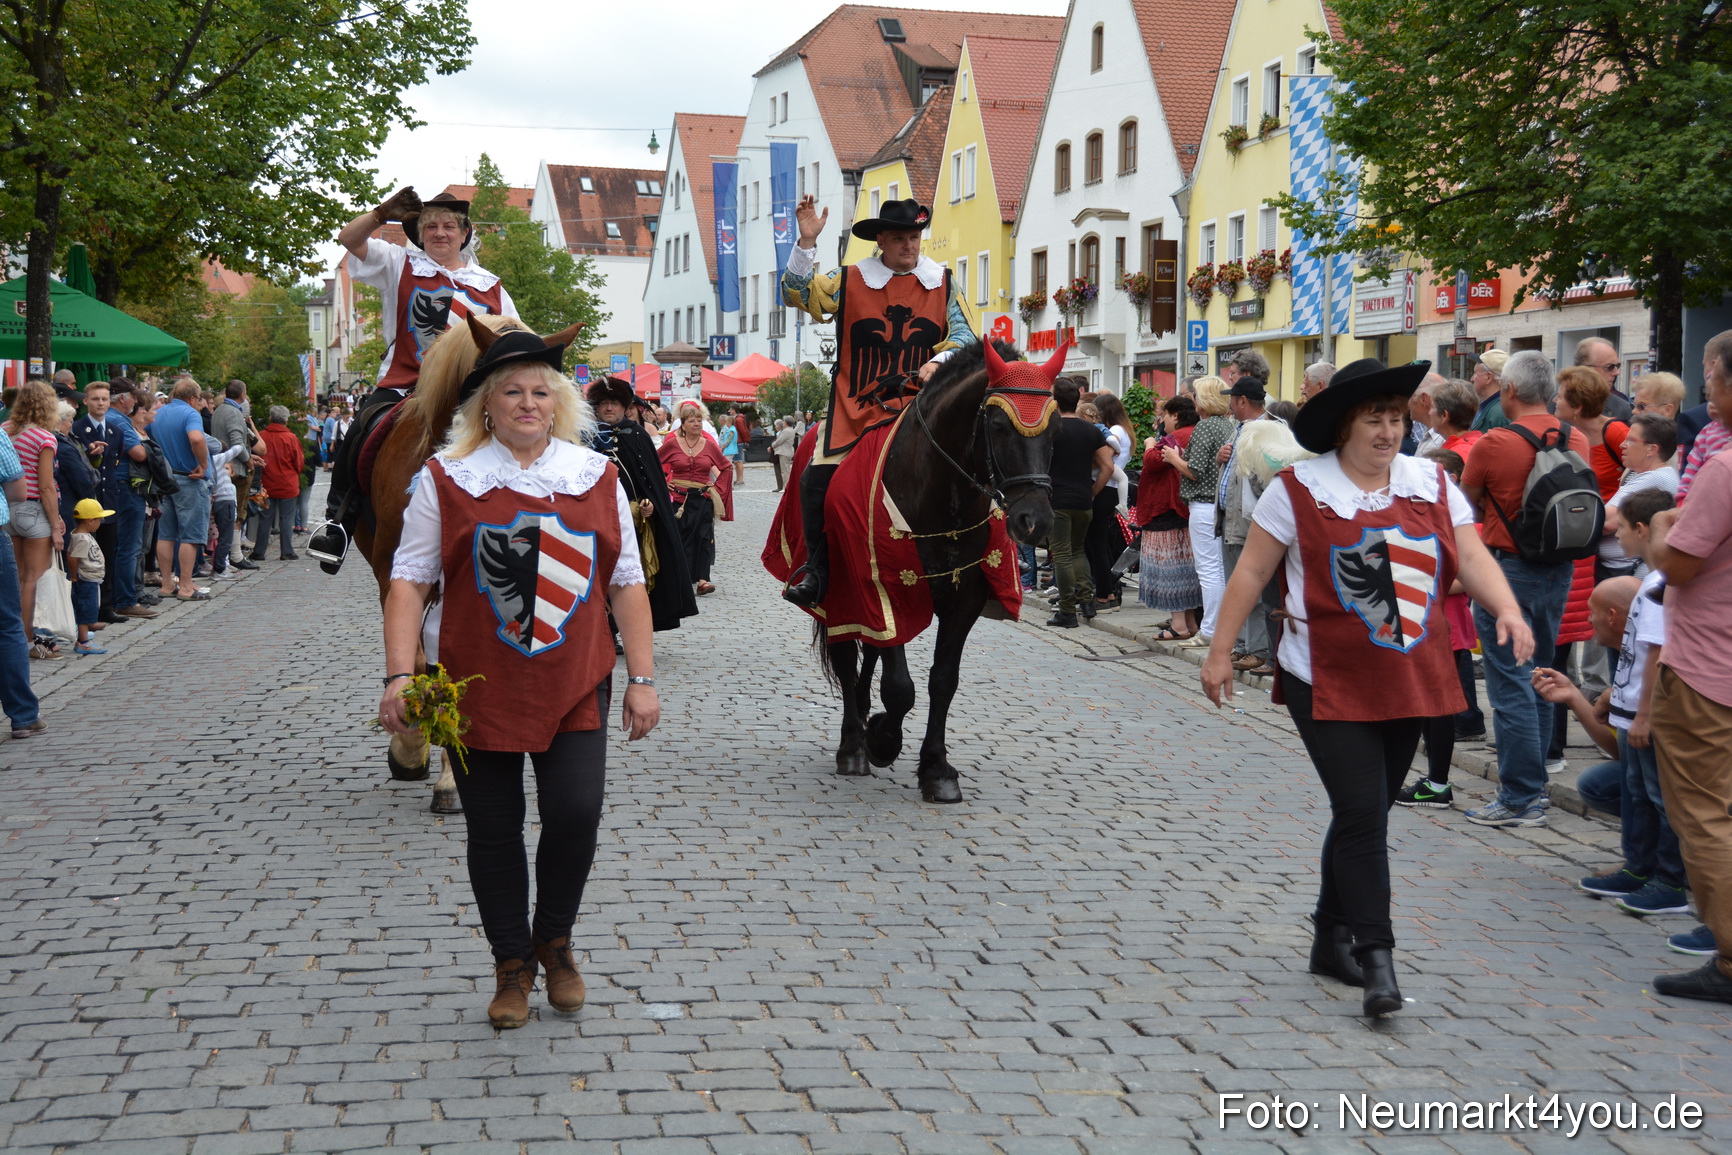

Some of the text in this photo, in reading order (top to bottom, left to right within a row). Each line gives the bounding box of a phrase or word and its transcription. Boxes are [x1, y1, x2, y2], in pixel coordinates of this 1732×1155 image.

[774, 206, 787, 244] K&L
[1471, 286, 1493, 298] DER
[1363, 297, 1395, 312] RIALTO KINO
[1405, 272, 1414, 329] KINO
[1436, 295, 1449, 308] DER
[1230, 306, 1243, 316] WOLLE
[1192, 324, 1204, 348] P
